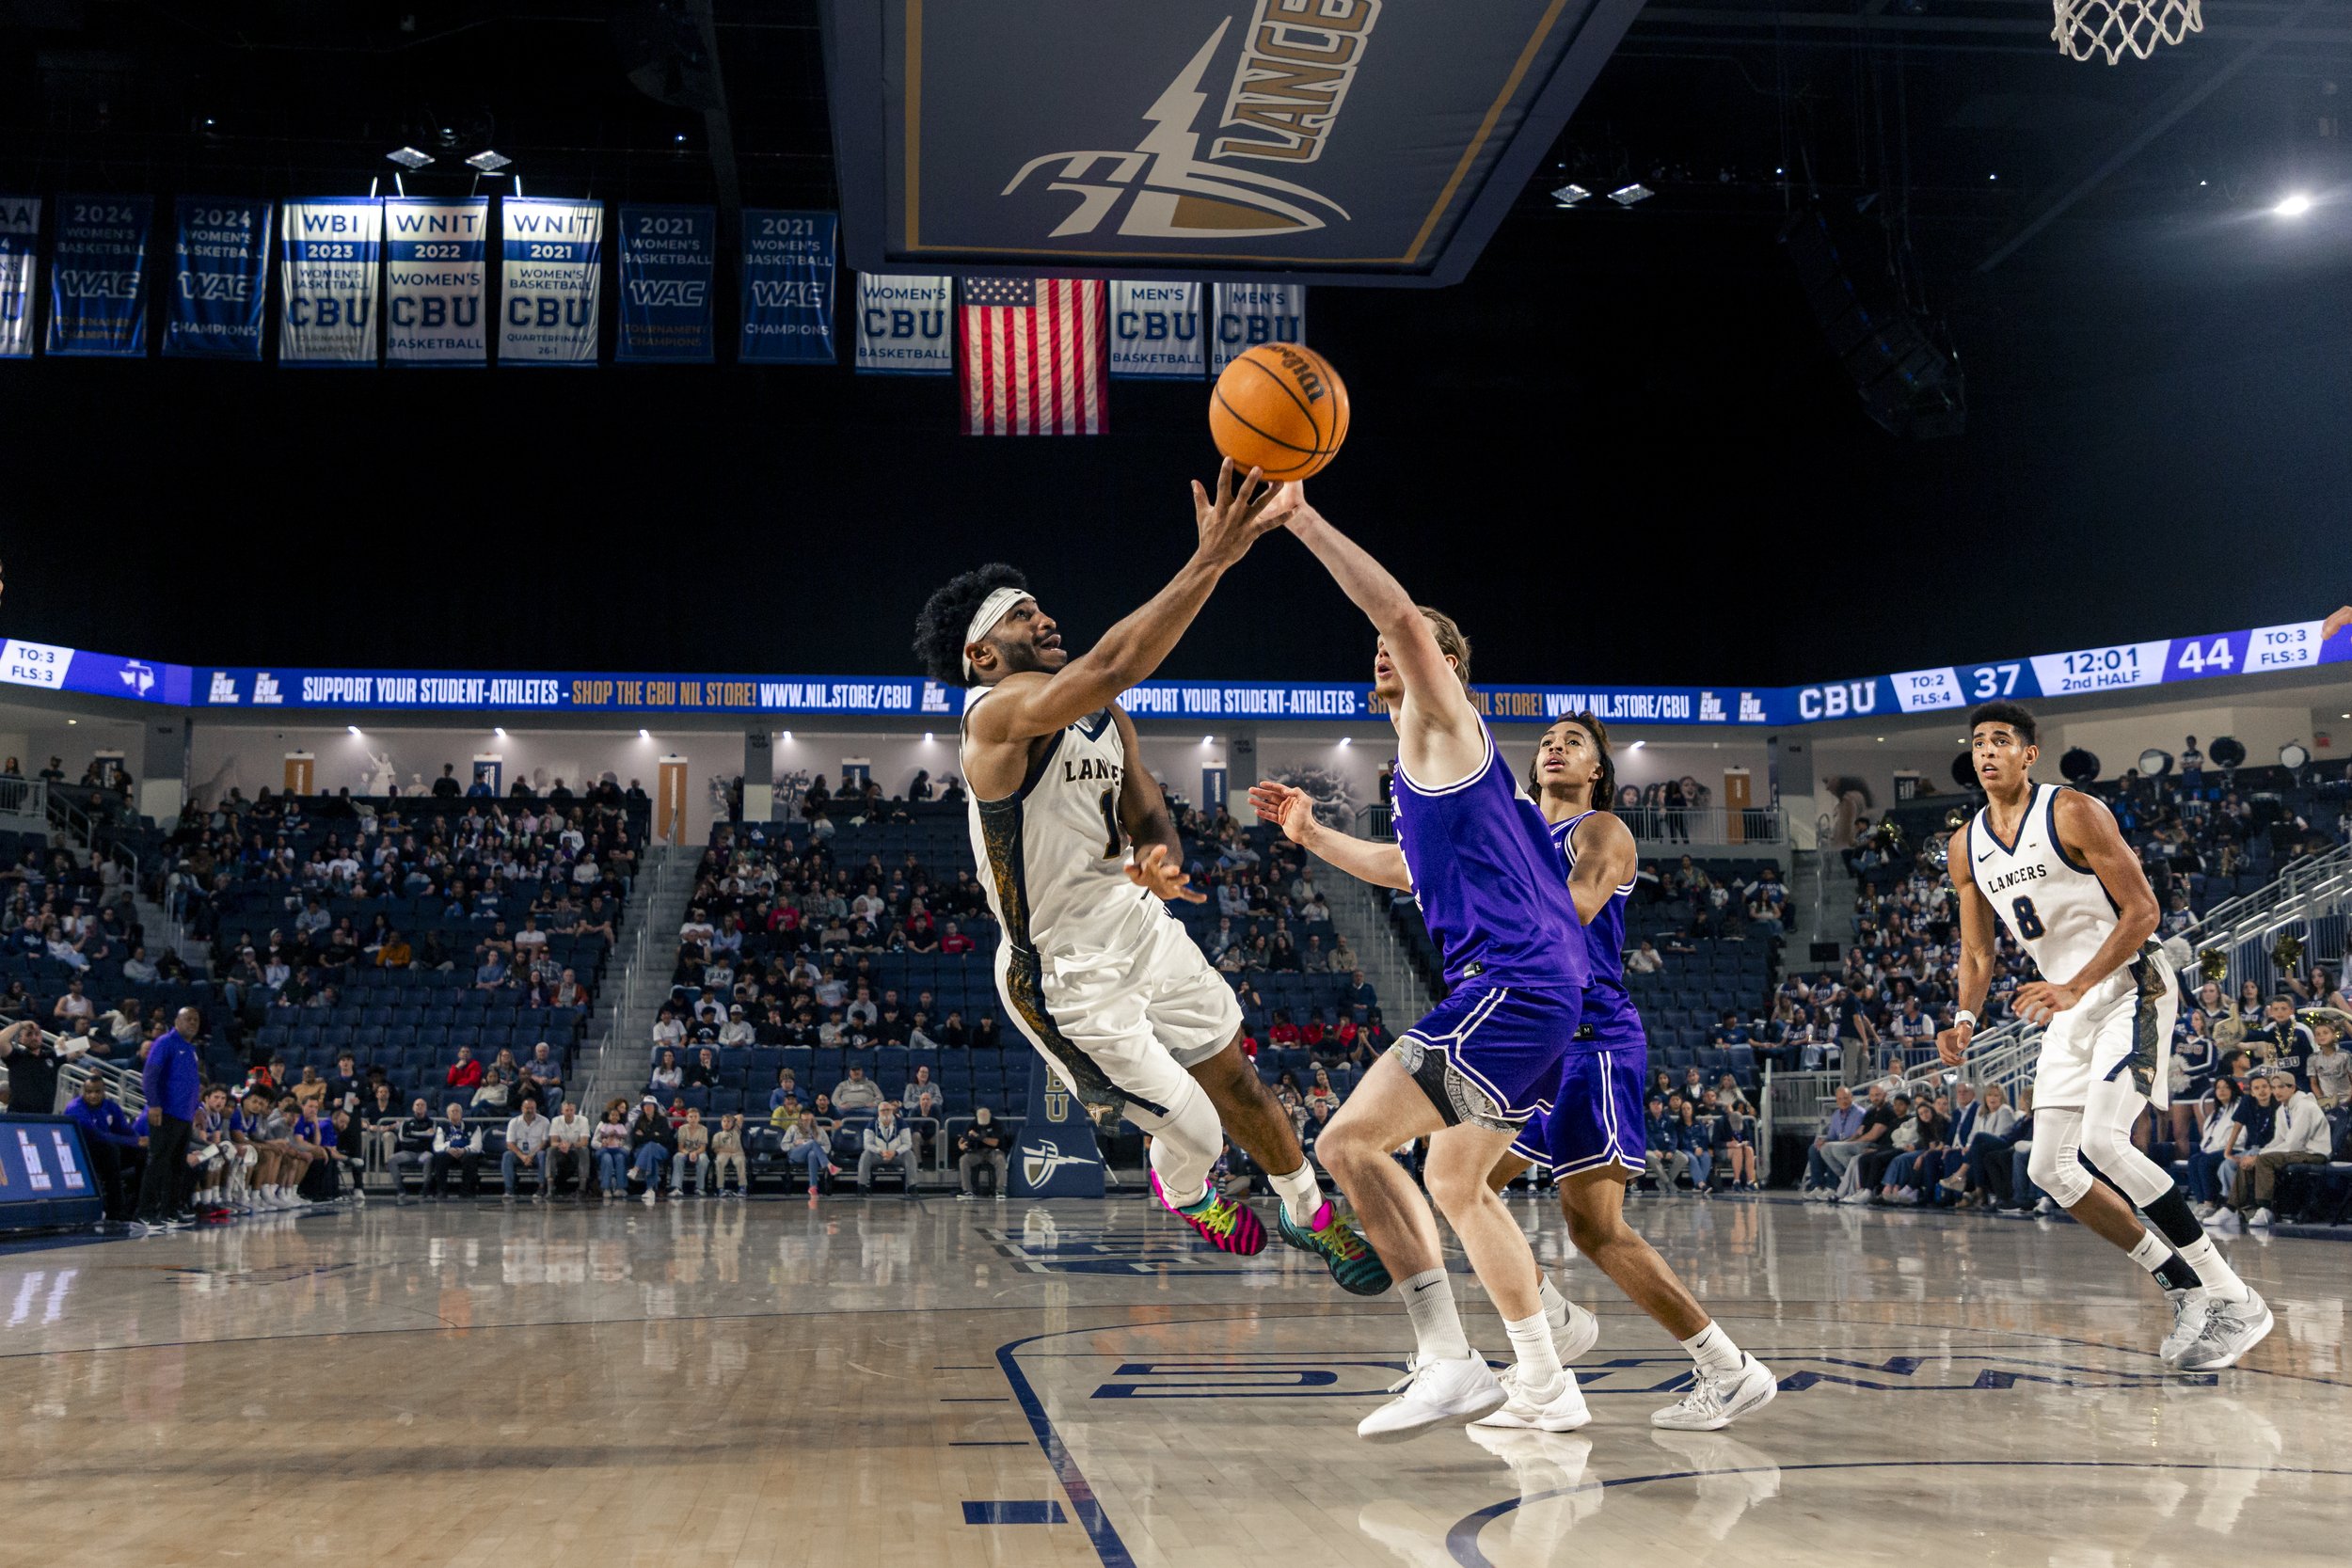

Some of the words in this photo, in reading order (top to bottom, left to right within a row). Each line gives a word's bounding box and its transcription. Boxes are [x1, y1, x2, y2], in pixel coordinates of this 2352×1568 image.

[74, 204, 134, 223] 2024
[191, 208, 251, 228] 2024
[304, 215, 358, 232] WBI
[396, 215, 478, 232] WNIT
[514, 215, 594, 234] WNIT
[640, 217, 693, 235] 2021
[761, 218, 814, 235] 2021
[66, 228, 135, 239] WOMEN'S
[185, 230, 252, 244] WOMEN'S
[57, 243, 145, 256] BASKETBALL
[176, 244, 262, 260] BASKETBALL
[308, 245, 354, 258] 2023
[415, 245, 461, 259] 2022
[531, 245, 572, 259] 2021
[630, 238, 700, 250] WOMEN'S
[752, 240, 820, 252] WOMEN'S
[623, 253, 713, 265] BASKETBALL
[745, 254, 832, 267] BASKETBALL
[300, 269, 362, 279] WOMEN'S
[390, 273, 481, 286] WOMEN'S
[520, 269, 583, 279] WOMEN'S
[60, 269, 140, 299] WAC
[293, 280, 370, 290] BASKETBALL
[510, 280, 592, 291] BASKETBALL
[628, 280, 706, 307] WAC
[752, 280, 825, 308] WAC
[863, 288, 946, 300] WOMEN'S
[1132, 288, 1184, 301] MEN'S
[1233, 293, 1285, 305] MEN'S
[289, 298, 370, 326] CBU
[392, 297, 479, 326] CBU
[508, 297, 591, 327] CBU
[170, 321, 257, 337] CHAMPIONS
[745, 324, 829, 336] CHAMPIONS
[863, 309, 945, 340] CBU
[1117, 311, 1198, 341] CBU
[1219, 312, 1299, 344] CBU
[389, 339, 484, 349] BASKETBALL
[858, 348, 949, 359] BASKETBALL
[1113, 353, 1202, 364] BASKETBALL
[2265, 631, 2294, 645] TO:
[2297, 629, 2307, 641] 3
[18, 647, 43, 661] TO:
[46, 652, 55, 663] 3
[2063, 647, 2137, 675] 12:01
[2178, 638, 2233, 673] 44
[2261, 650, 2296, 665] FLS:
[2297, 648, 2308, 660] 3
[11, 666, 43, 680] FLS:
[44, 670, 54, 682] 3
[1974, 663, 2021, 699] 37
[2061, 677, 2091, 691] 2nd
[2097, 671, 2140, 687] HALF
[211, 679, 235, 694] CBU
[255, 679, 279, 695] CBU
[303, 676, 373, 703] SUPPORT
[376, 677, 417, 704] YOUR
[421, 677, 559, 705] STUDENT-ATHLETES
[572, 680, 612, 705] SHOP
[616, 681, 643, 705] THE
[646, 681, 676, 705] CBU
[680, 682, 703, 706] NIL
[706, 682, 757, 706] STORE!
[760, 683, 913, 709] WWW.NIL.STORE/CBU
[922, 689, 946, 704] CBU
[1182, 689, 1222, 713] YOUR
[1224, 689, 1356, 715] STUDENT-ATHLETES
[1799, 680, 1876, 721] CBU
[1495, 692, 1544, 717] STORE!
[1546, 693, 1691, 719] WWW.NIL.STORE/CBU
[1699, 699, 1722, 713] CBU
[1740, 699, 1761, 713] CBU
[1099, 788, 1120, 860] 1
[1988, 863, 2047, 894] LANCERS
[2011, 895, 2047, 942] 8
[2277, 1055, 2301, 1069] CBU
